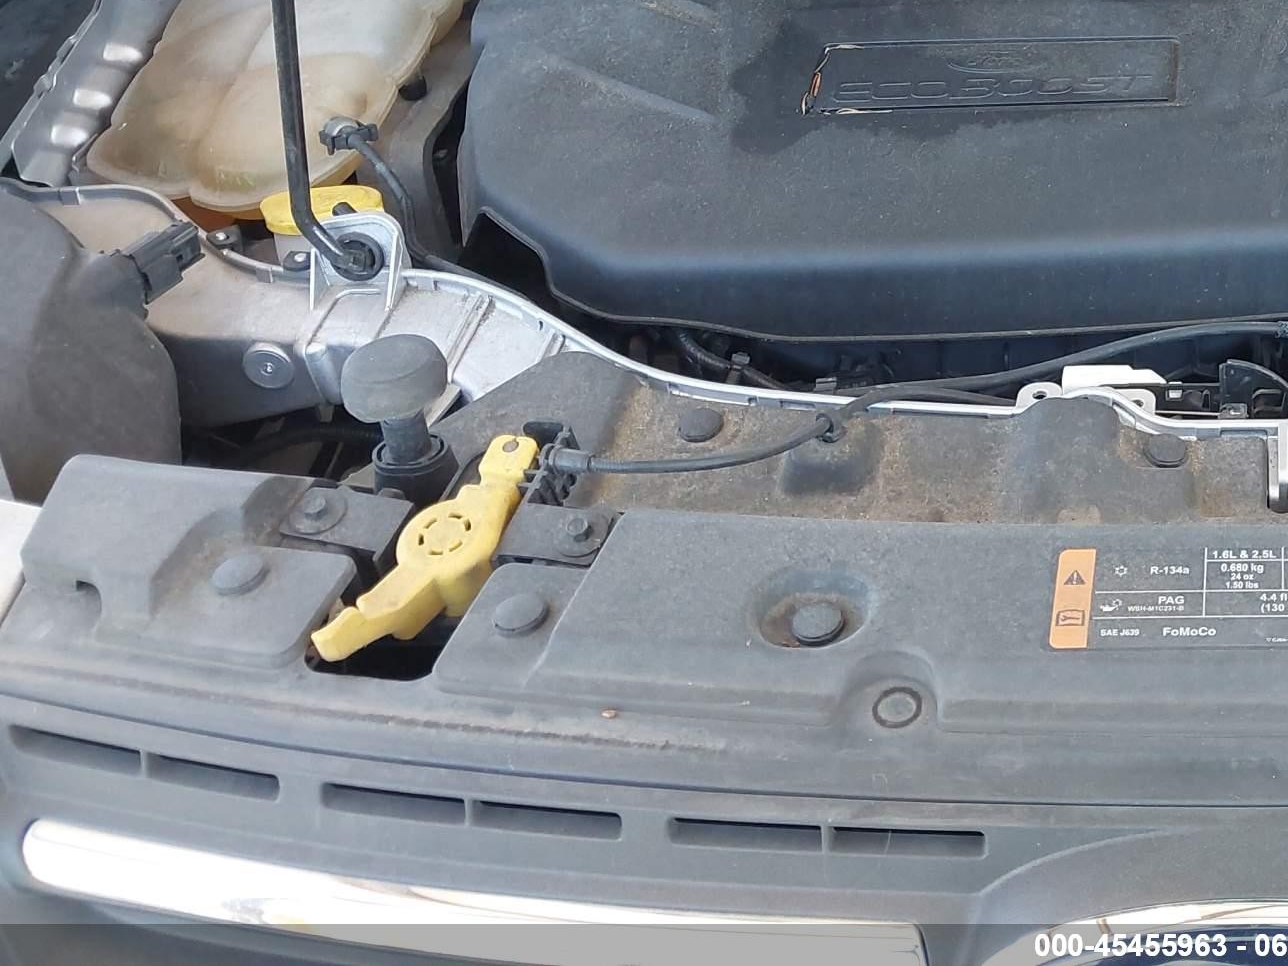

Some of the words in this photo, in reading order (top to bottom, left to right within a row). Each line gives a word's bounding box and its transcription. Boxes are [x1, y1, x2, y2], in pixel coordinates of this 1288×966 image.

[1213, 550, 1237, 559] 1.6L
[1240, 550, 1248, 559] &
[1252, 550, 1277, 559] 2.5L
[1150, 565, 1190, 575] R-134a
[1221, 563, 1248, 572] 0.680
[1251, 563, 1264, 573] kg
[1226, 581, 1244, 589] 1.50
[1245, 581, 1259, 589] lbs
[1158, 596, 1185, 605] PAG
[1260, 593, 1277, 601] 4.4
[1280, 593, 1288, 601] fl
[1261, 603, 1285, 613] (130
[1100, 628, 1118, 637] SAE
[1120, 628, 1140, 636] J639
[1162, 626, 1217, 637] FoMoCo
